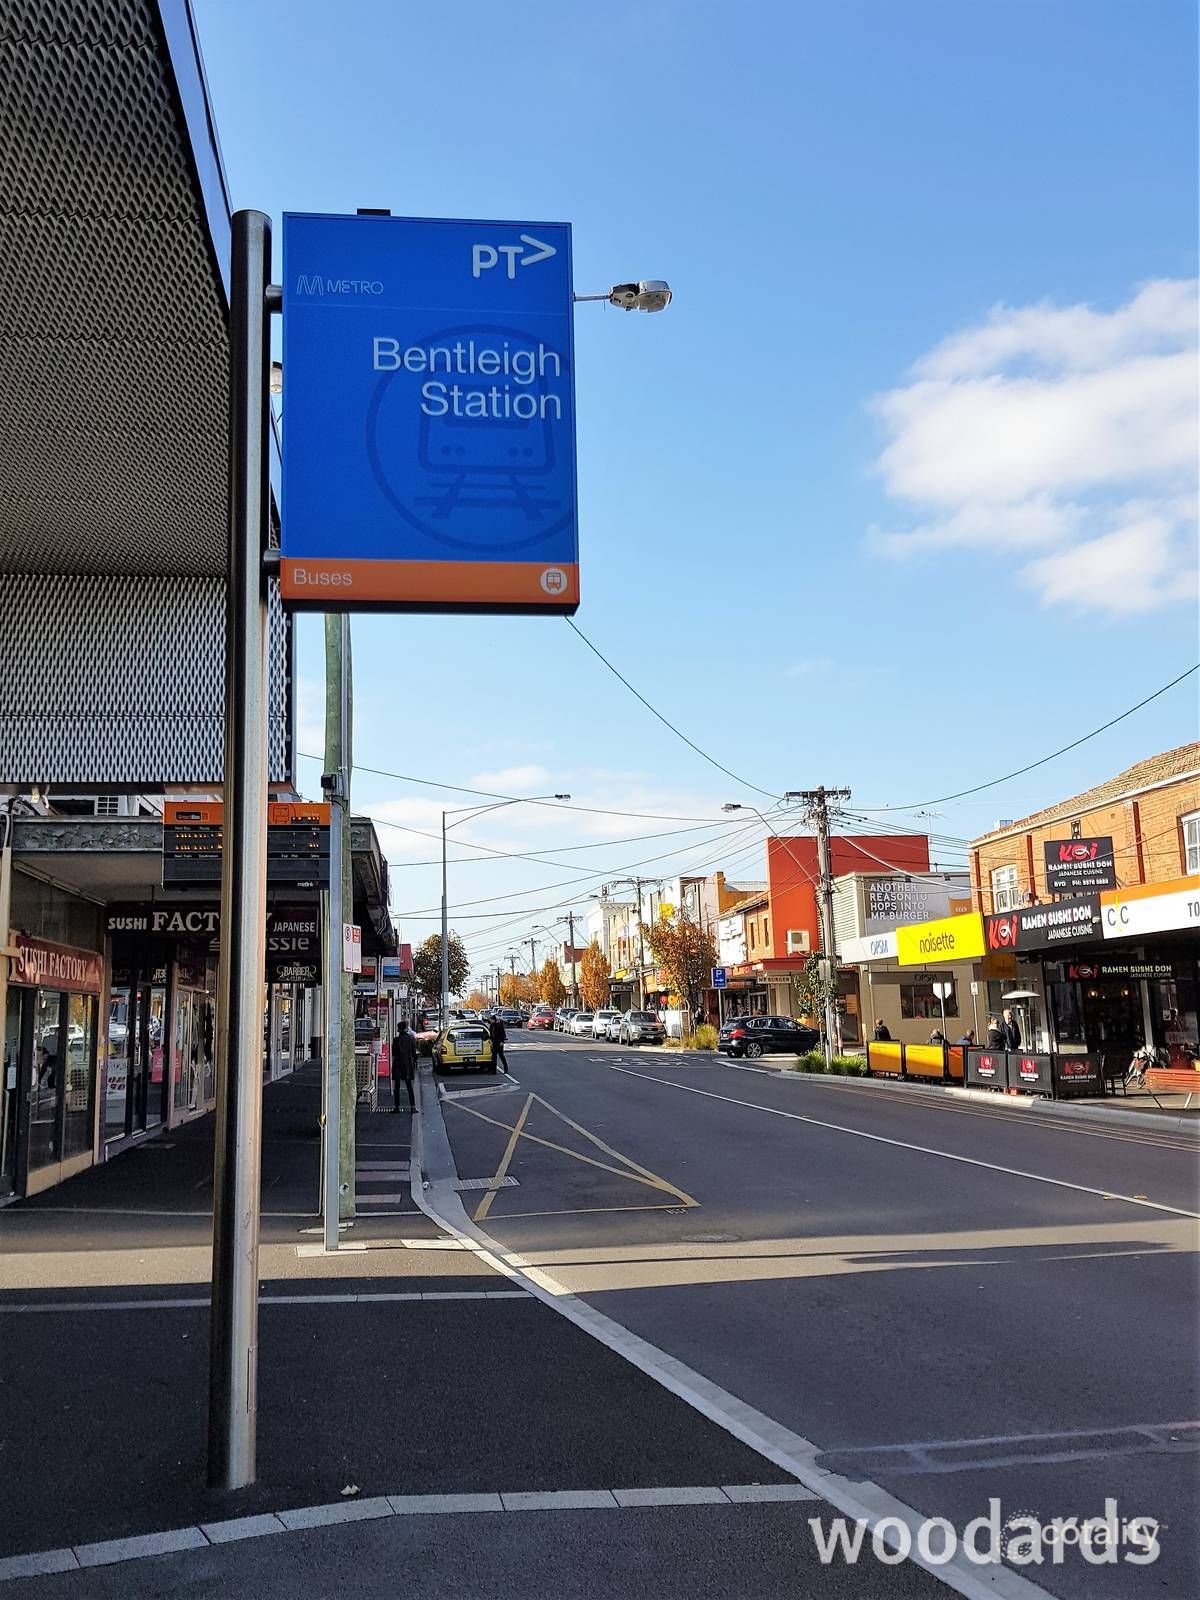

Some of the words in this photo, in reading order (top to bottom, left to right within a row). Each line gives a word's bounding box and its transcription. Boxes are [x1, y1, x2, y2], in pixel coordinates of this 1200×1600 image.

[326, 280, 384, 295] METRO
[373, 337, 560, 385] Bentleigh
[421, 381, 561, 419] Station
[294, 568, 352, 585] Buses
[1048, 863, 1072, 871] RAMEN
[1097, 860, 1112, 868] DON
[870, 882, 917, 891] ANOTHER
[870, 892, 911, 901] REASON
[913, 892, 928, 901] TO
[871, 902, 897, 911] HOPS
[901, 901, 925, 910] INTO
[871, 911, 886, 920] MR
[889, 911, 930, 920] BURGER
[1021, 915, 1047, 931] RAMEN
[1048, 910, 1073, 926] SUSHI
[1073, 905, 1092, 921] DON
[107, 917, 147, 930] SUSHI
[273, 921, 316, 933] JAPANESE
[1047, 929, 1071, 941] JAPANESE
[1072, 924, 1093, 936] CUISINE
[870, 939, 889, 955] OPSM
[18, 945, 47, 975] SUSHI
[49, 953, 87, 981] FACTORY
[1130, 965, 1153, 973] SUSHI
[1155, 964, 1172, 972] DON
[715, 969, 723, 978] P
